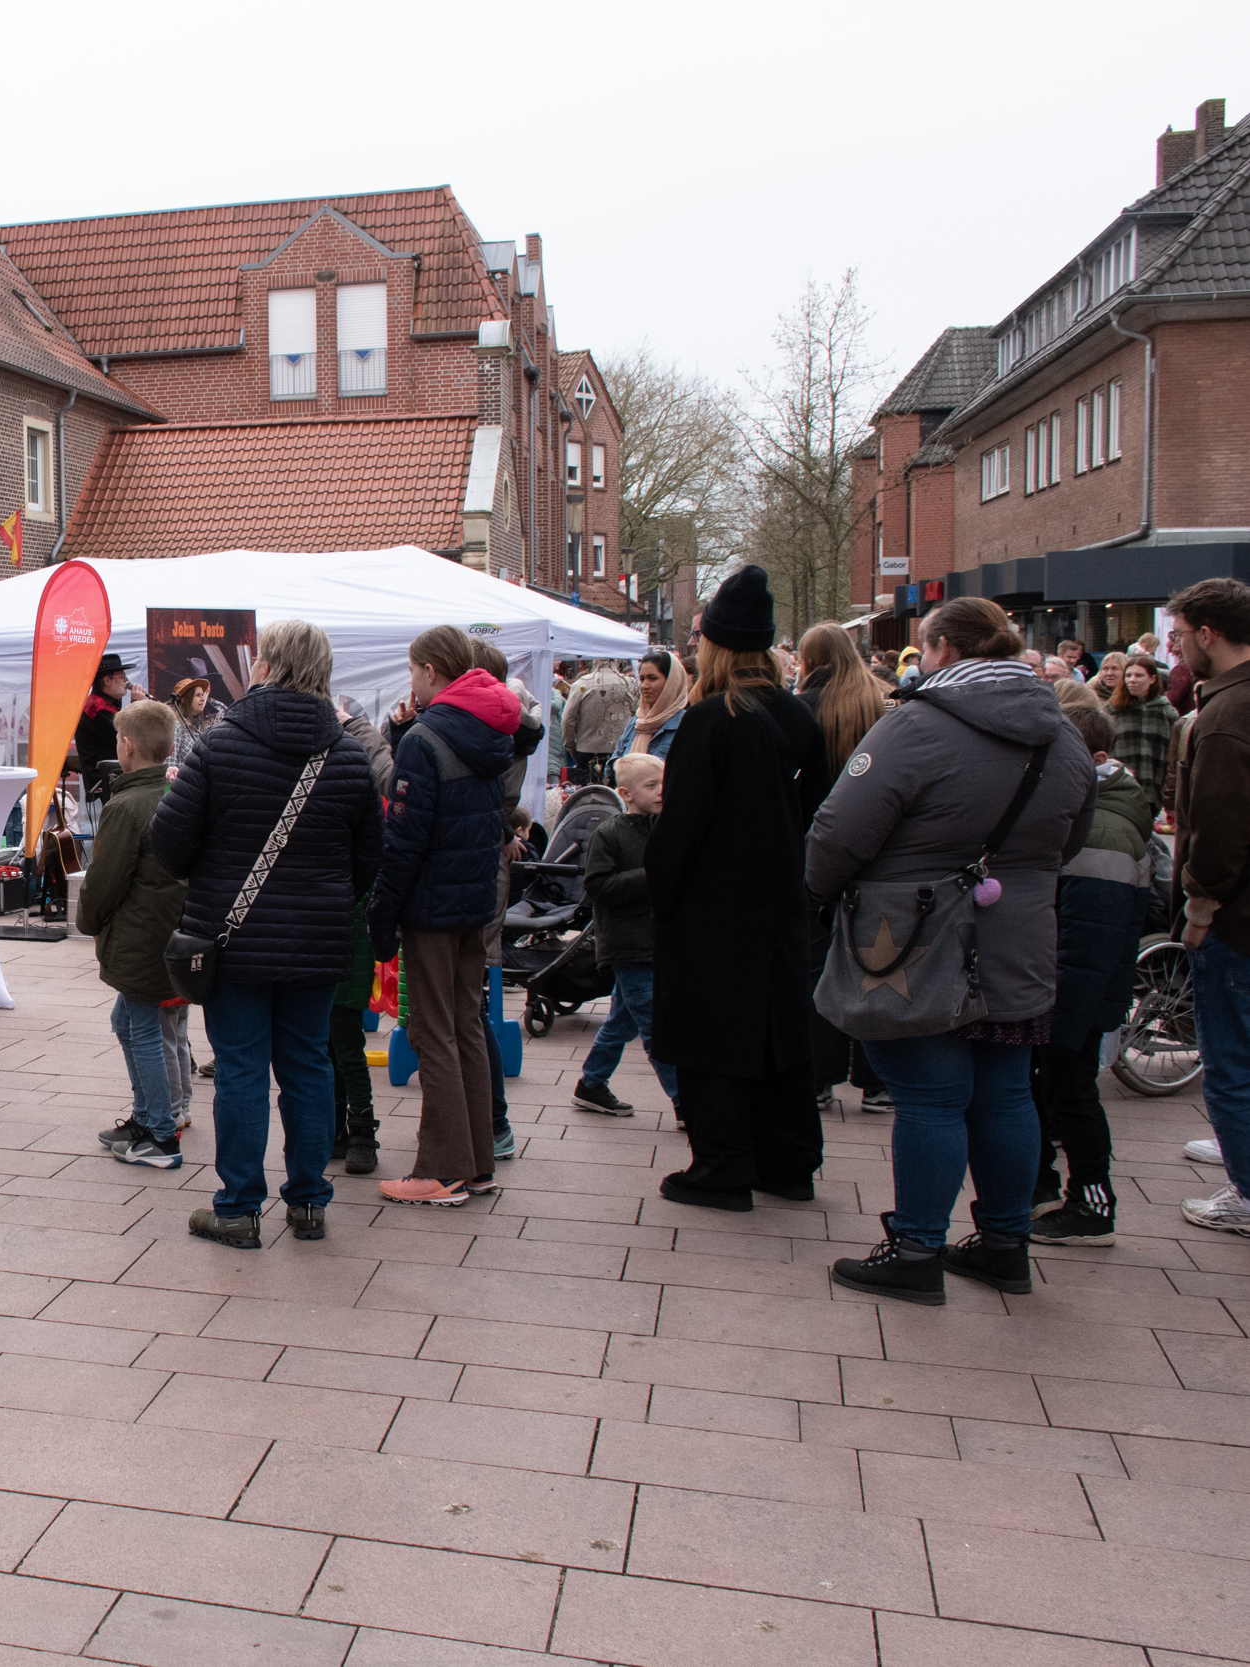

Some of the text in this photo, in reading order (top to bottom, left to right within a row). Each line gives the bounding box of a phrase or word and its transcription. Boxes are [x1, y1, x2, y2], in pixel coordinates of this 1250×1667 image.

[883, 561, 907, 569] Gabor
[69, 627, 92, 636] AHAUS
[172, 620, 195, 637] John
[69, 634, 96, 645] VREDEN
